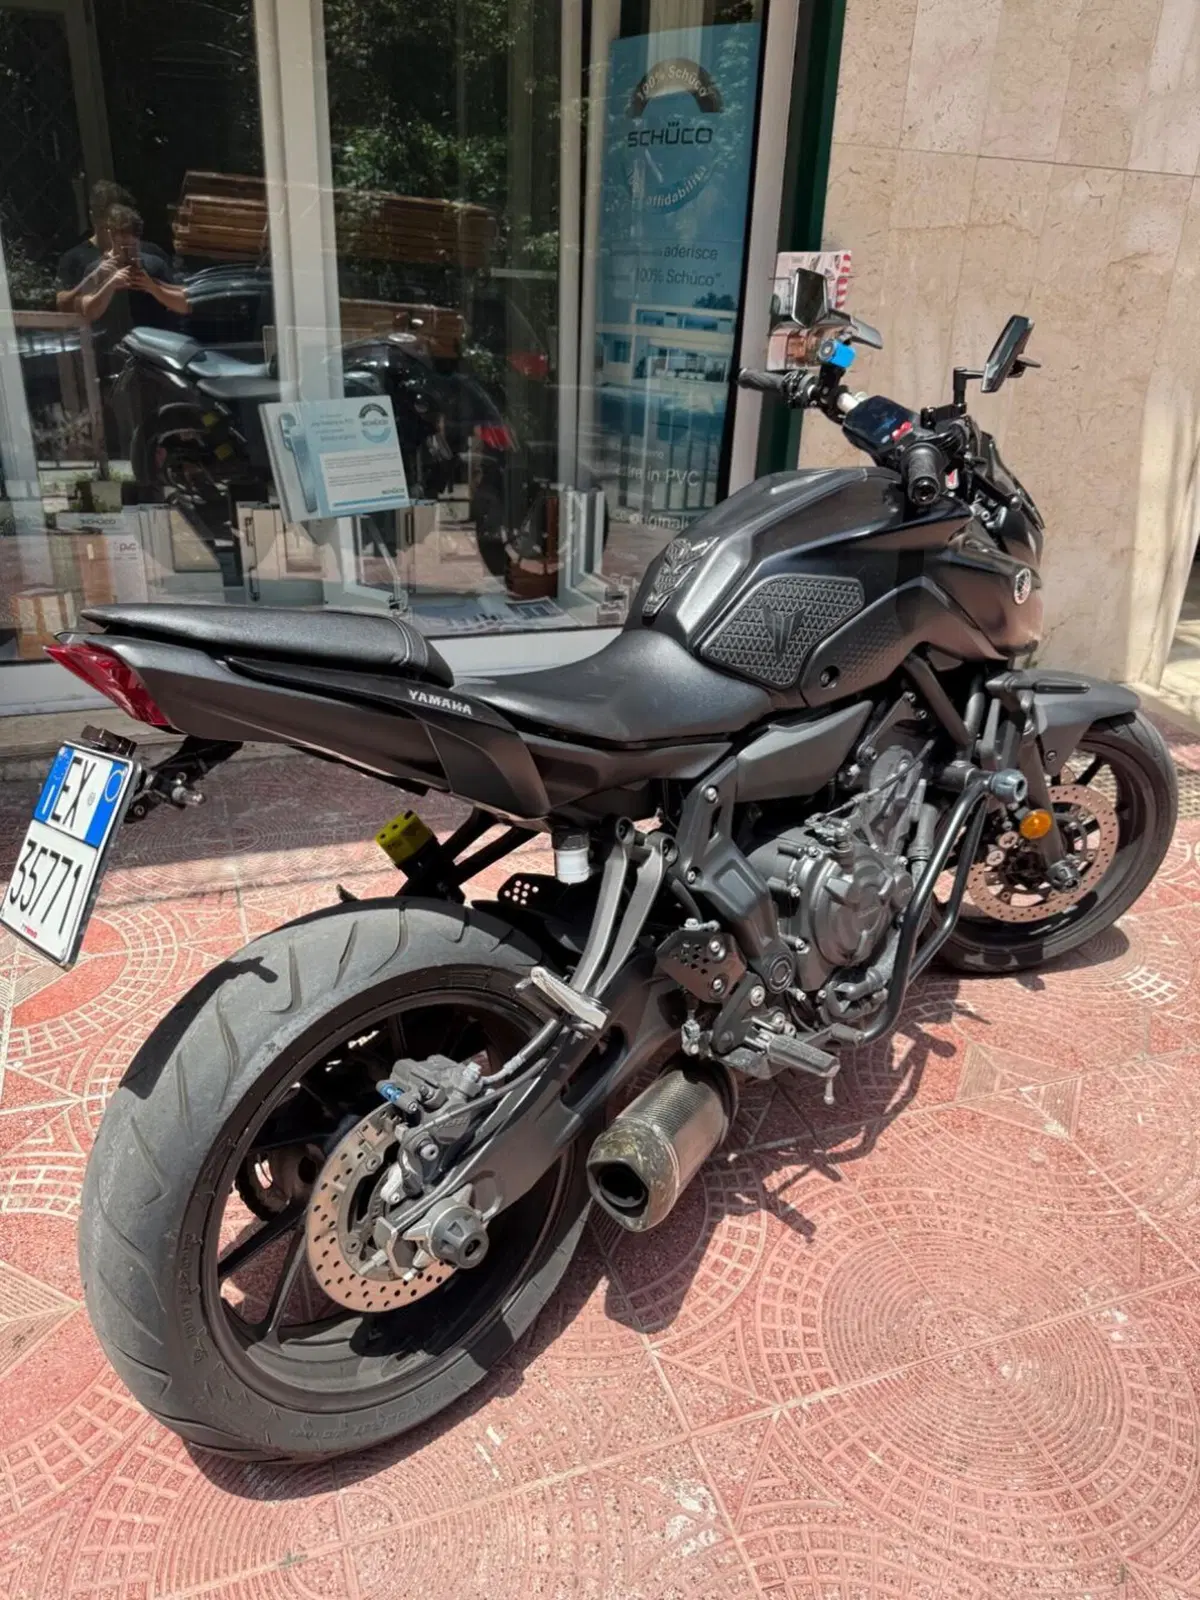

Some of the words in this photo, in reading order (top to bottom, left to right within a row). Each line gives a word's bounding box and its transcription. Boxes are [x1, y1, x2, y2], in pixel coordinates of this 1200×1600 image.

[627, 121, 714, 147] SCHÜCO
[664, 467, 699, 487] PVC
[408, 688, 473, 716] YAMAHA
[51, 756, 97, 829] EX
[10, 839, 83, 935] 35771
